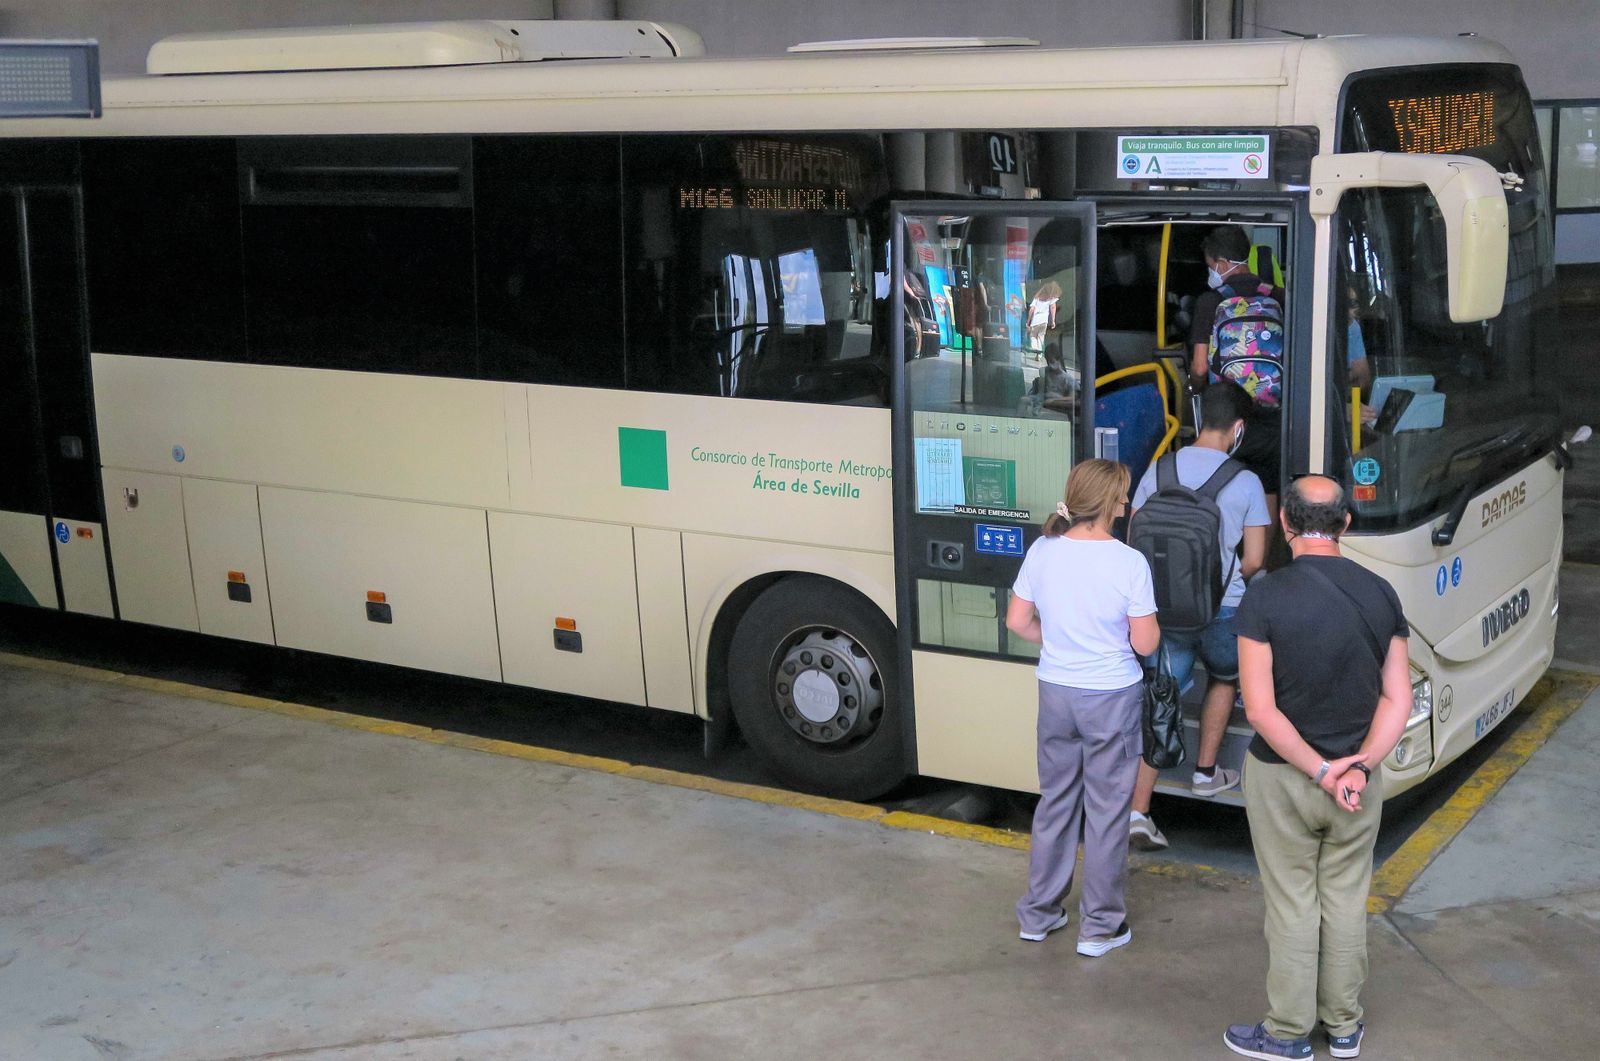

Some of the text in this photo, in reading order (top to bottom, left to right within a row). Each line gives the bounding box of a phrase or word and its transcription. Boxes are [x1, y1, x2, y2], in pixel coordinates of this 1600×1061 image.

[1128, 141, 1146, 151] Viaja
[1148, 141, 1184, 150] tranquilo.
[1186, 141, 1200, 149] Bus
[1217, 140, 1232, 149] aire
[1234, 140, 1259, 150] limpio
[680, 188, 733, 208] M166
[747, 188, 827, 209] SANLUCAR
[691, 447, 747, 465] Consorcio
[751, 452, 766, 467] de
[768, 453, 833, 474] Transporte
[753, 471, 860, 499] Área de Sevilla
[955, 506, 1030, 519] SALIDA DE EMERGENCIA
[1481, 480, 1527, 528] DAMAS
[1481, 587, 1530, 648] IVECO
